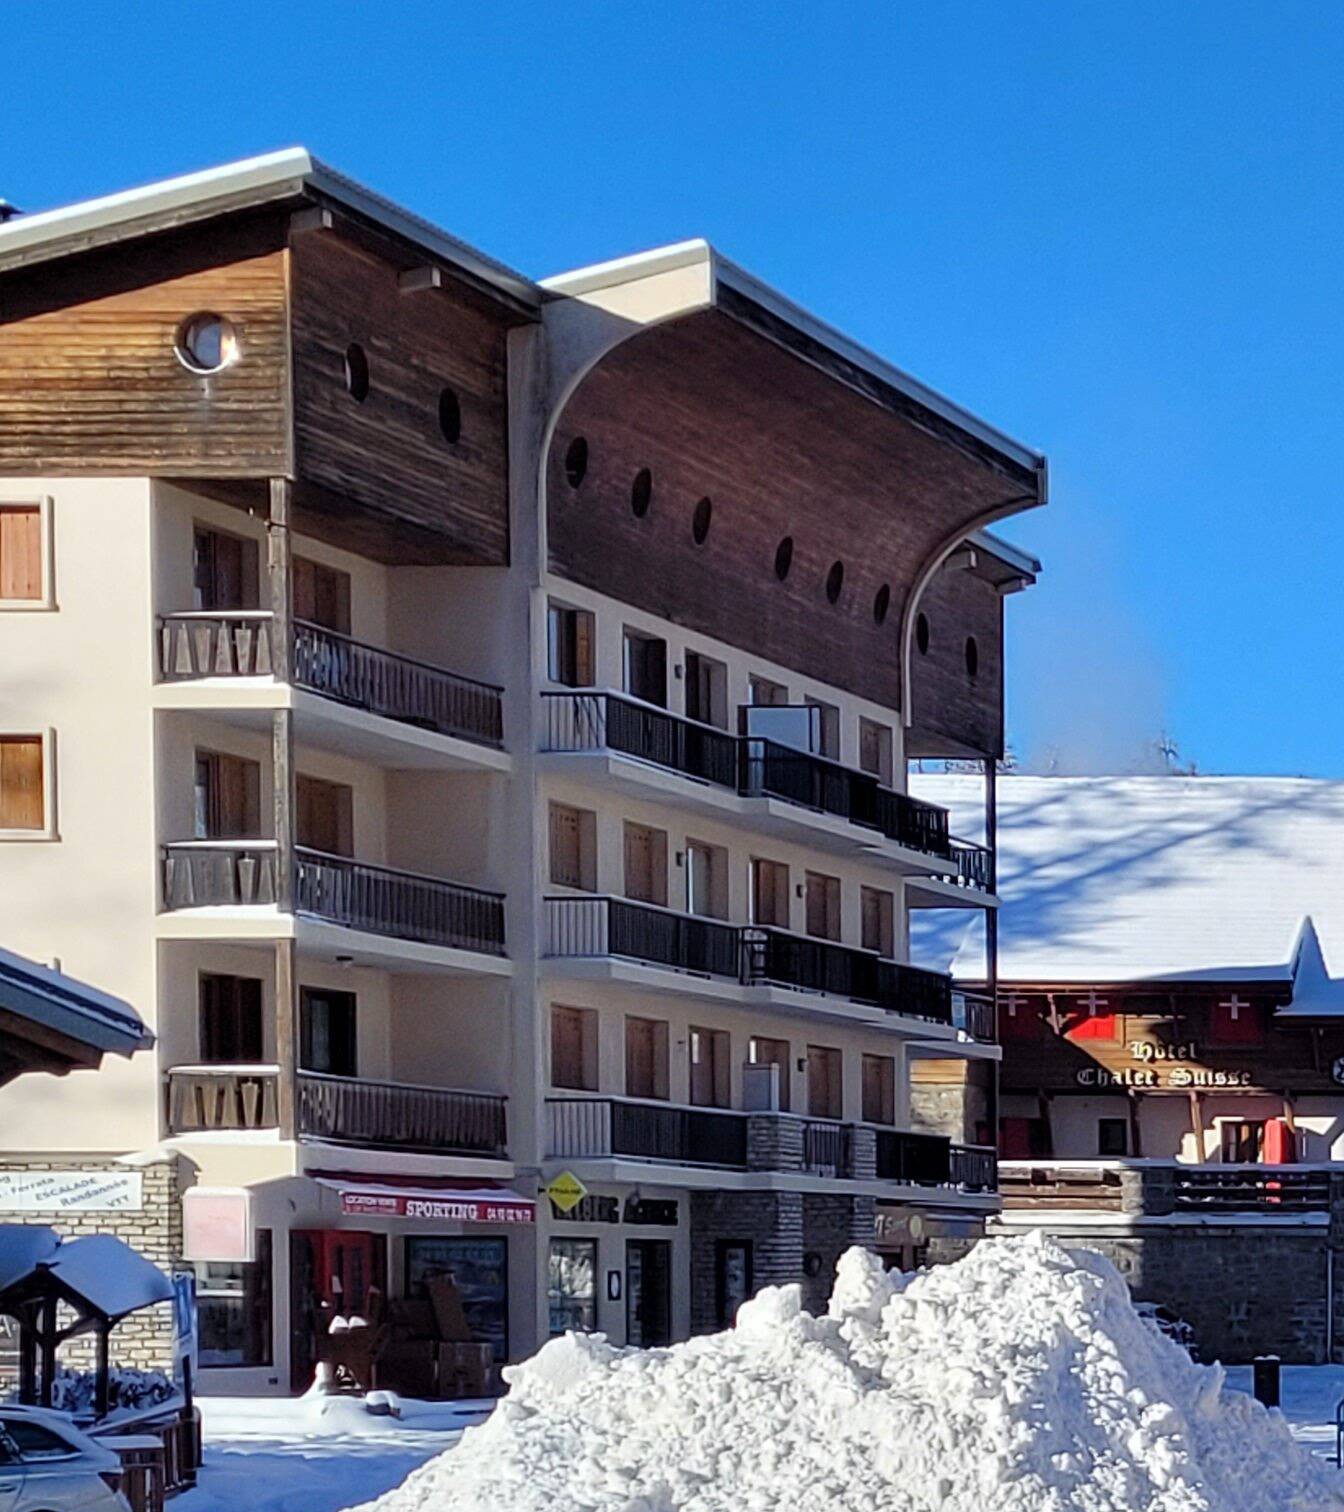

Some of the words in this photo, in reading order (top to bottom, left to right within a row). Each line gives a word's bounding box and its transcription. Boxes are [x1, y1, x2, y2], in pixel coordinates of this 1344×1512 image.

[1130, 1040, 1198, 1063] Hôtel
[1076, 1067, 1155, 1087] Chalet
[1167, 1067, 1251, 1087] Suisse
[35, 1178, 97, 1201] ESCALADE
[406, 1200, 477, 1220] SPORTING
